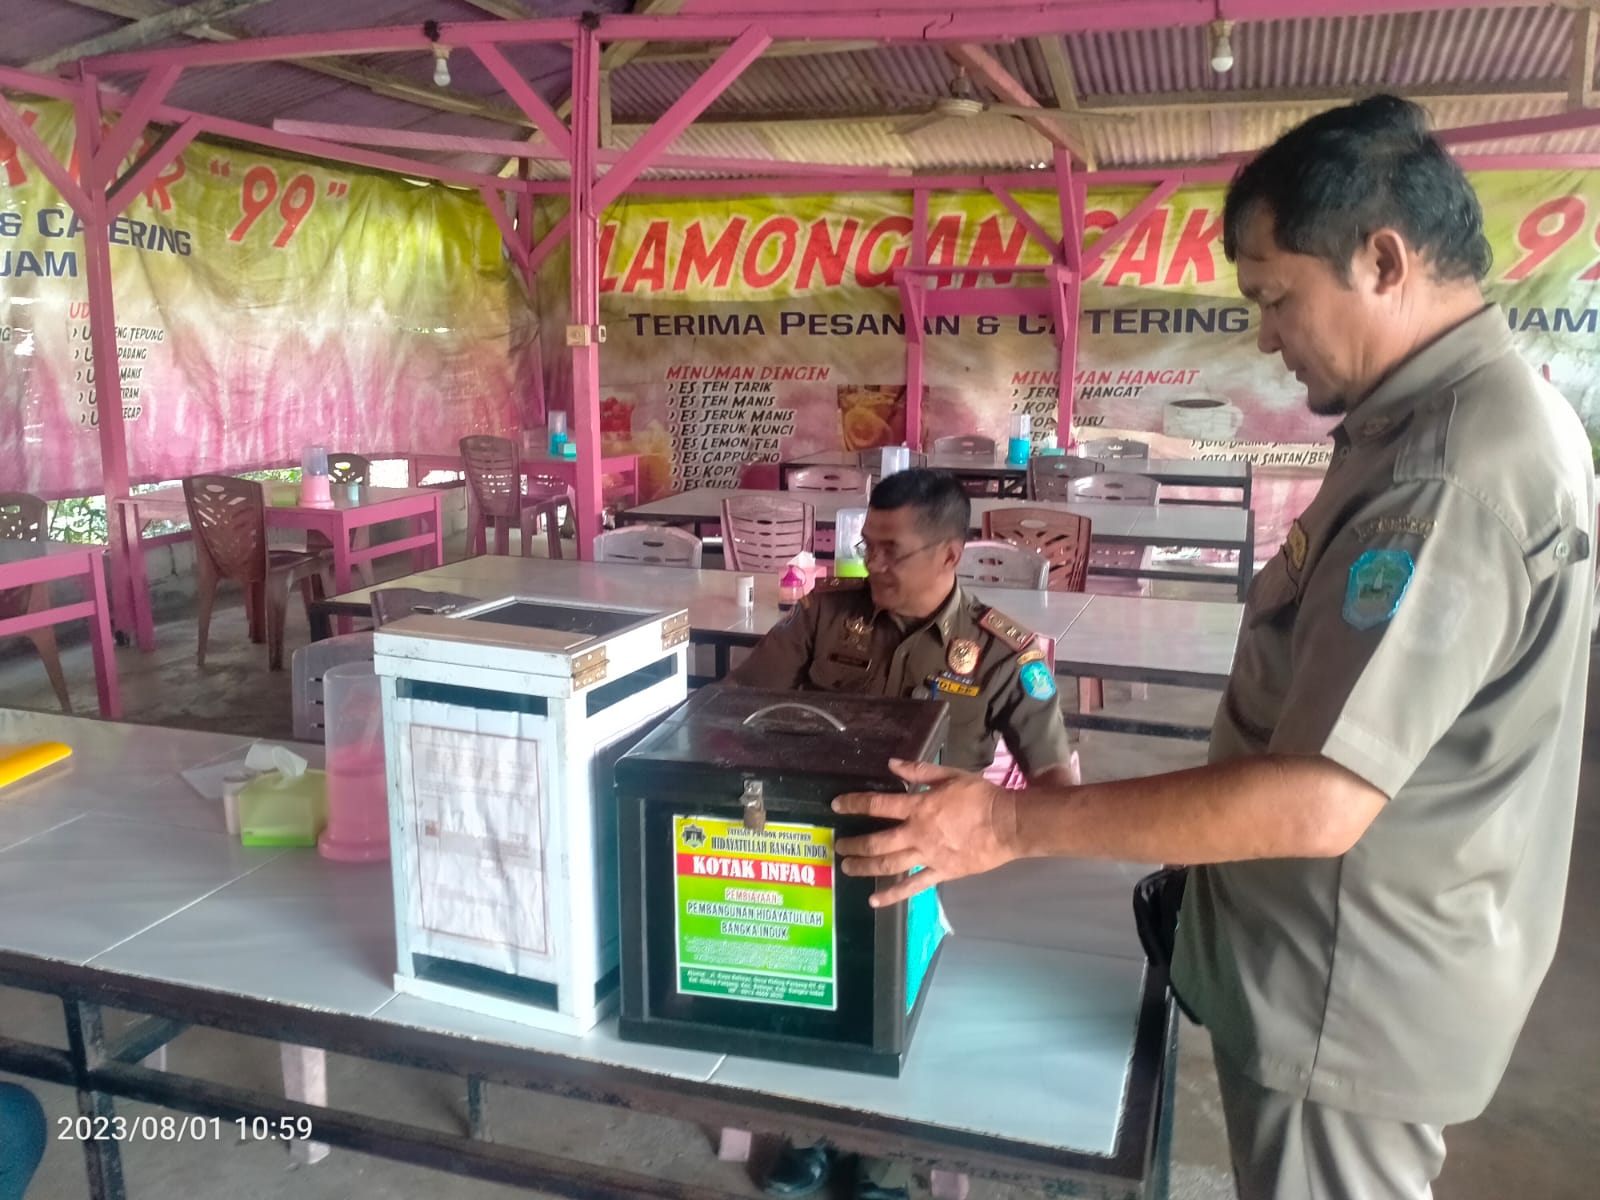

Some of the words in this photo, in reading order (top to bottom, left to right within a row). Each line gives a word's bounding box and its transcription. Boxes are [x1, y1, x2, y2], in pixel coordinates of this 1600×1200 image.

[37, 209, 191, 256] CAERING
[599, 216, 1028, 292] LAMONGAN
[1504, 194, 1600, 282] 9
[629, 313, 765, 336] TERIMA
[1018, 308, 1249, 335] CTERING
[130, 327, 164, 341] TEPUNG
[666, 366, 754, 380] MINUMAN
[759, 366, 830, 380] DINGIN
[1117, 370, 1200, 384] HANGAT
[679, 382, 695, 394] ES
[702, 382, 729, 394] TEH
[734, 382, 773, 394] TARIK
[1080, 386, 1143, 399] HANGAT
[679, 396, 695, 408] ES
[701, 396, 728, 408] TEH
[732, 396, 775, 408] MANIS
[1022, 401, 1058, 414] KOP
[122, 407, 141, 419] ECAP
[680, 410, 696, 422] ES
[700, 410, 746, 422] JERUK
[750, 410, 794, 422] MANIS
[681, 424, 697, 436] ES
[700, 424, 747, 436] JERUK
[751, 424, 794, 436] KUNCI
[682, 438, 698, 450] ES
[701, 438, 750, 450] LEMON
[754, 438, 779, 450] TEA
[682, 452, 698, 464] ES
[683, 466, 699, 478] ES
[702, 466, 737, 478] KOPI
[684, 479, 700, 490] ES
[711, 836, 767, 854] HIDAYATULLAH
[769, 842, 801, 857] BANGKA
[804, 845, 828, 859] INDUK
[692, 856, 756, 880] KOTAK
[761, 861, 816, 885] INFAQ
[687, 902, 754, 918] PEMBANGUNAN
[756, 909, 822, 925] HIDAYATULLAH
[721, 922, 758, 936] BANGKA
[759, 925, 787, 938] INDUK
